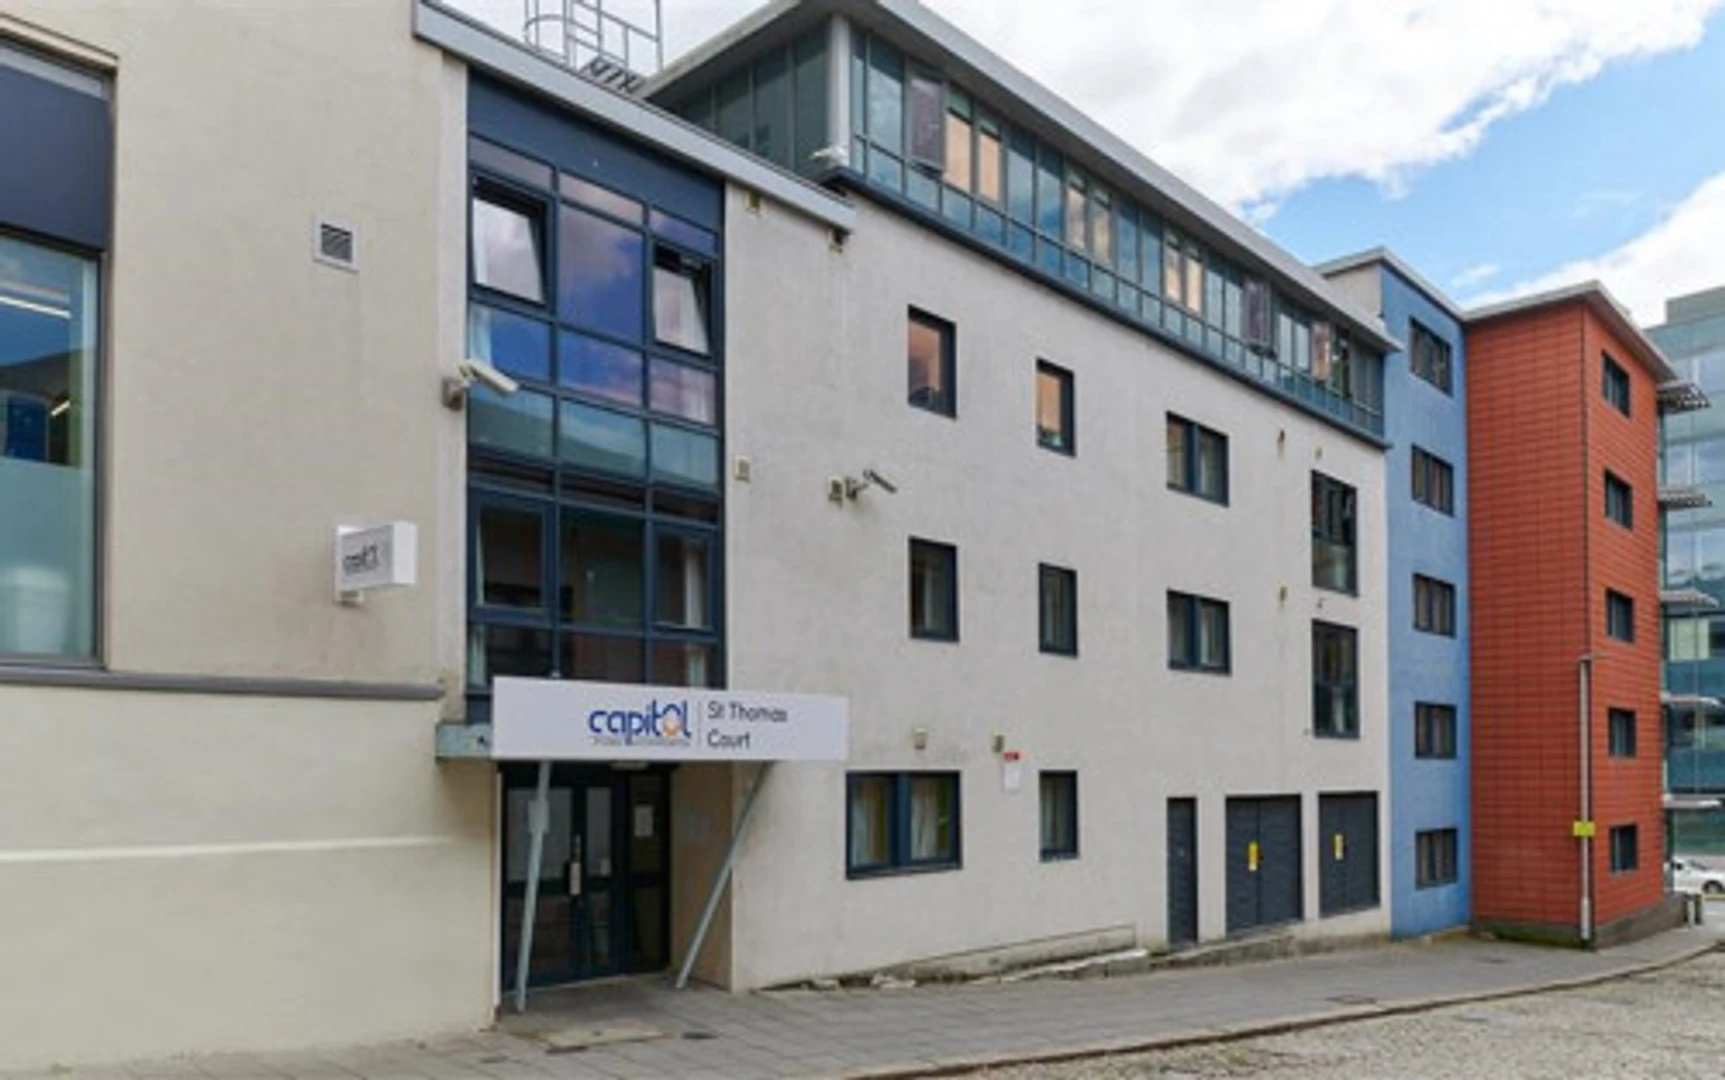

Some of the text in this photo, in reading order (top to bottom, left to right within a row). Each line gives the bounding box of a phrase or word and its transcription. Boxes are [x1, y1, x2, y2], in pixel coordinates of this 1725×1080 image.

[707, 700, 788, 723] St Thomas
[707, 728, 750, 749] Court
